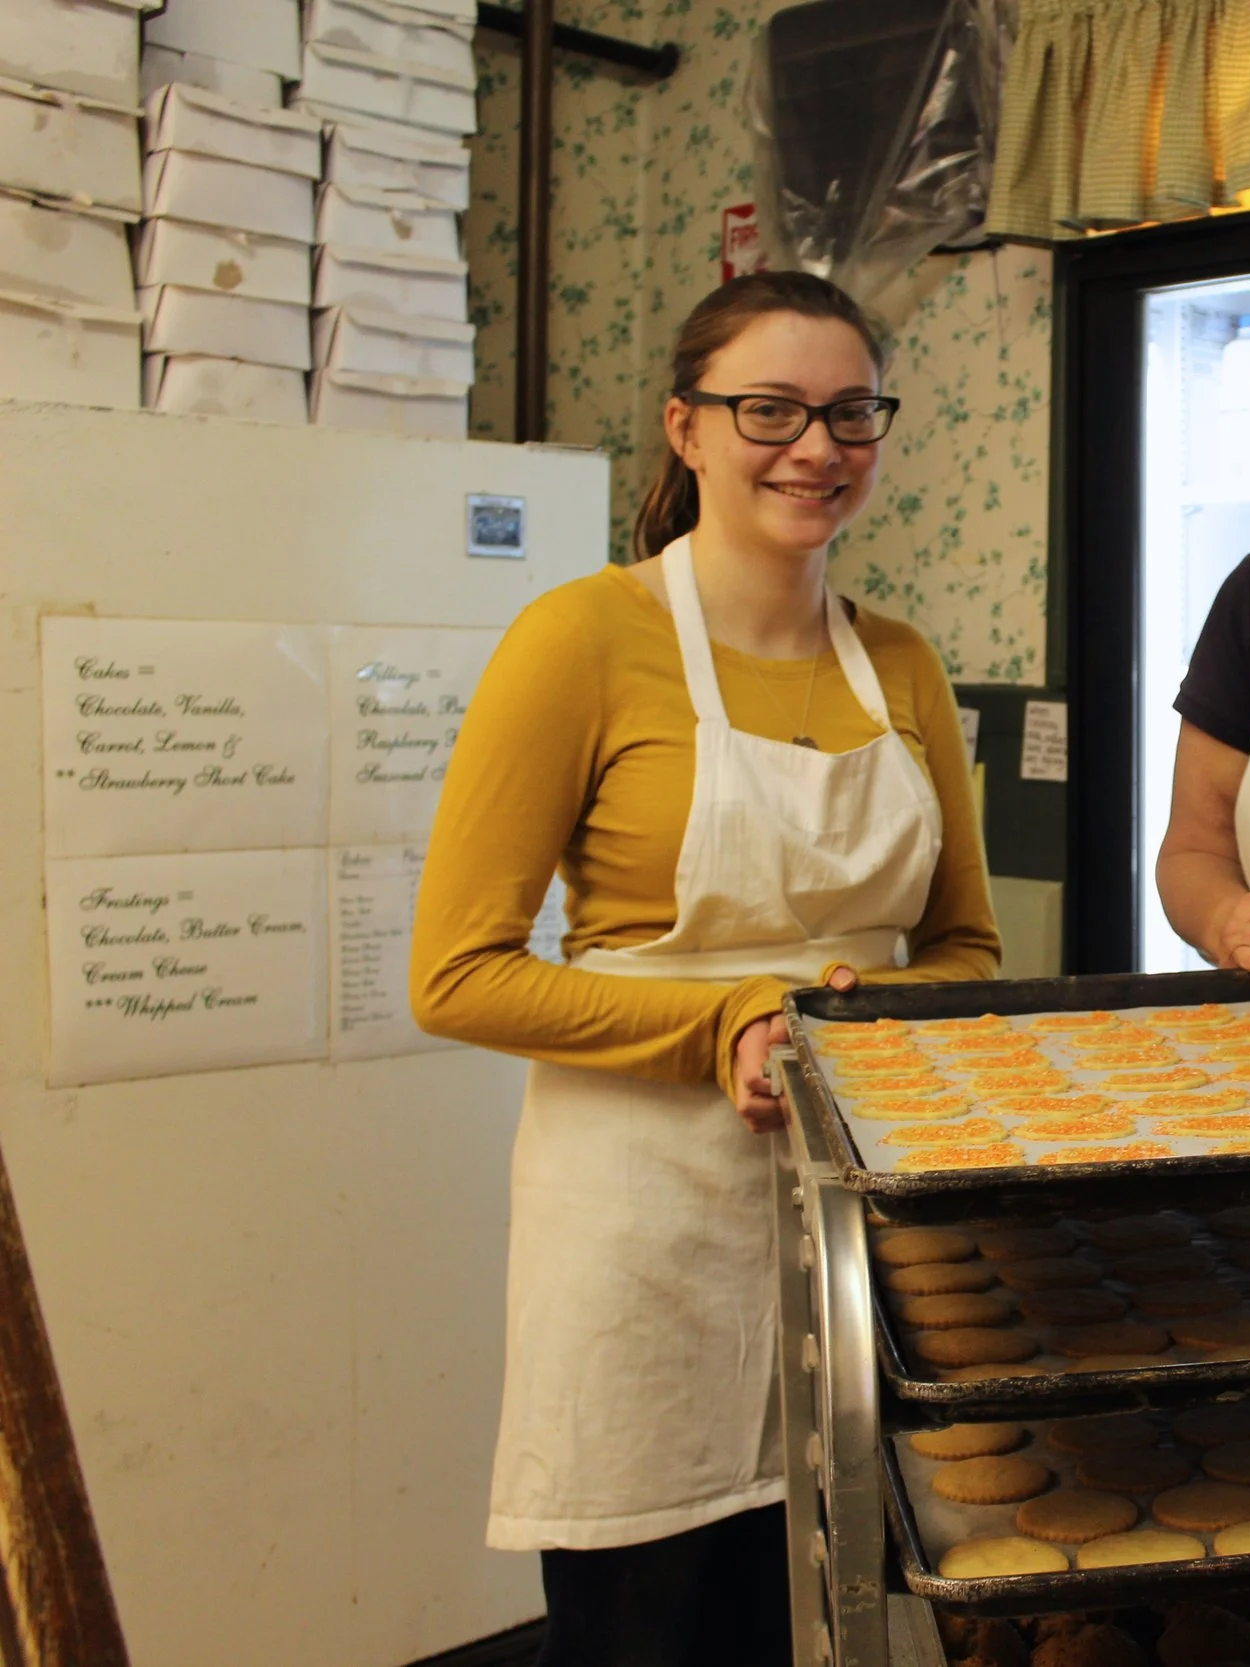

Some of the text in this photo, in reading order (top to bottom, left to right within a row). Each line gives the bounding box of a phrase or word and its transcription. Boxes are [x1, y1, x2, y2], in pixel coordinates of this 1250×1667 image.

[75, 656, 130, 681] Cakes
[75, 692, 245, 718] Chocolate, Vanilla,
[76, 730, 243, 760] Carrot, Lemon &
[356, 728, 438, 757] Raspberry
[78, 764, 297, 796] Strawberry Short Cake
[80, 887, 169, 915] Frostings
[80, 925, 170, 948] Chocolate,
[178, 917, 242, 941] Butter
[82, 955, 208, 986] Cream Cheese
[116, 986, 259, 1023] Whipped Cream
